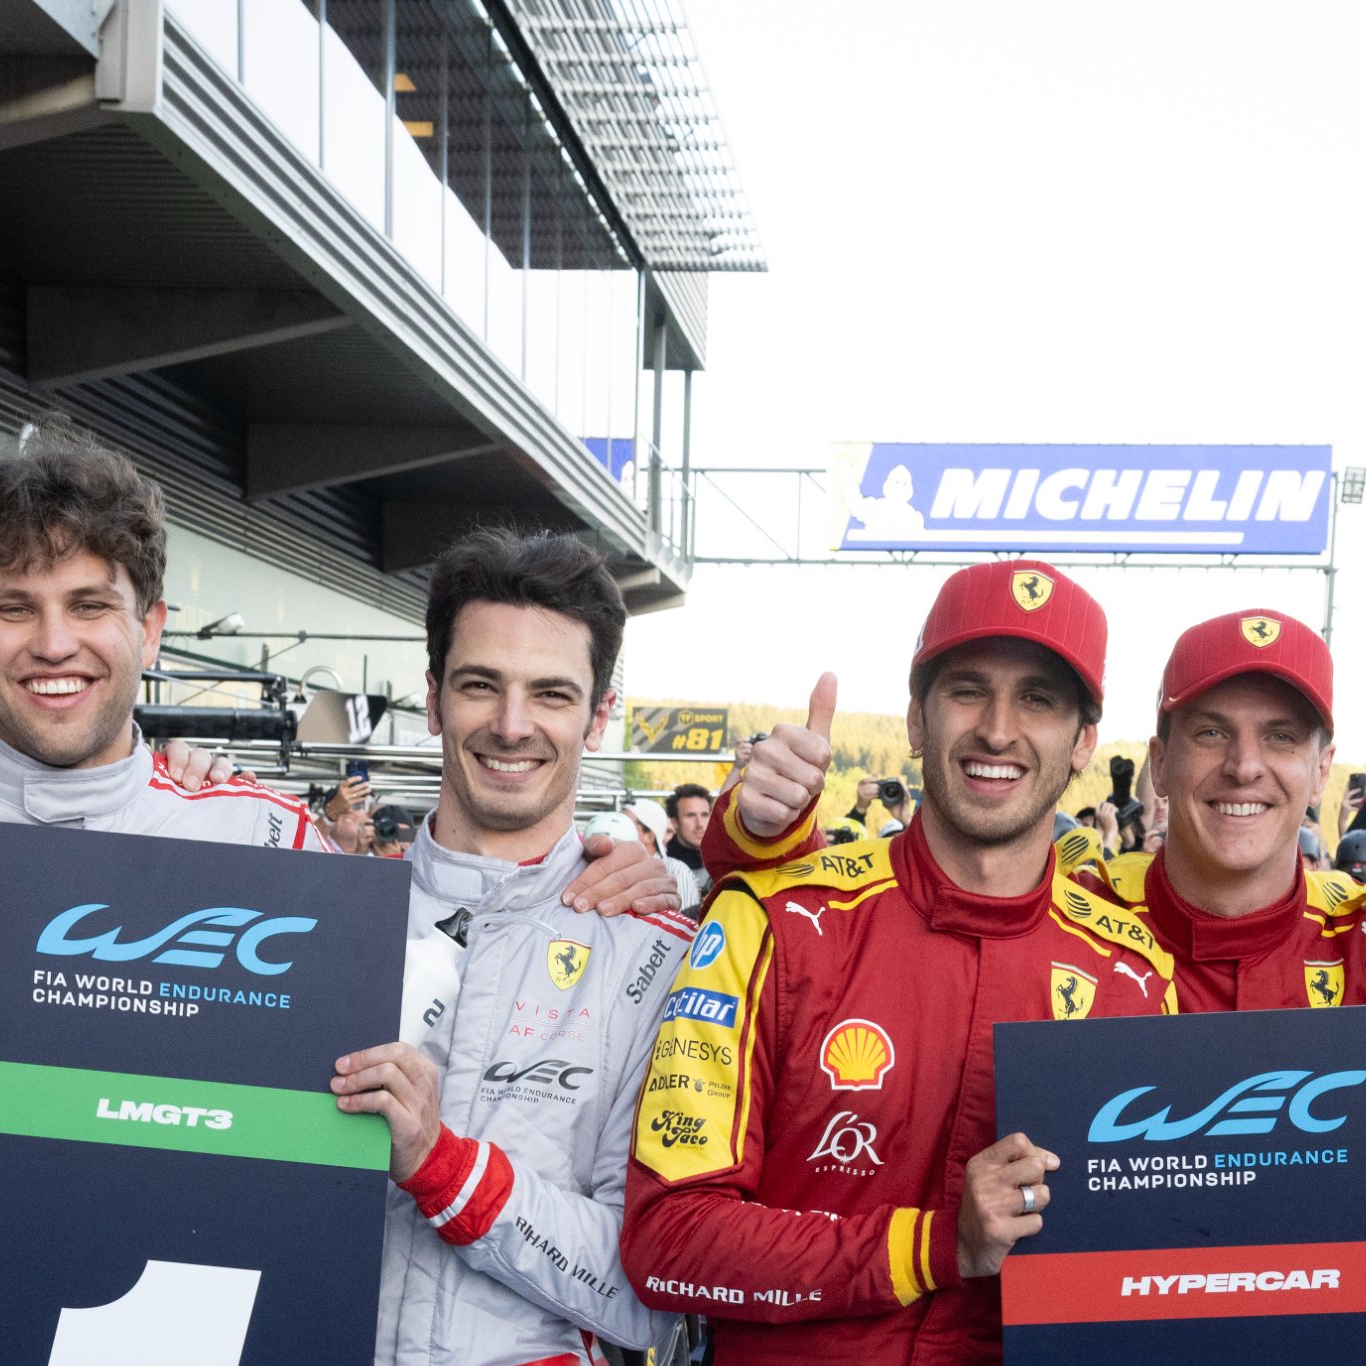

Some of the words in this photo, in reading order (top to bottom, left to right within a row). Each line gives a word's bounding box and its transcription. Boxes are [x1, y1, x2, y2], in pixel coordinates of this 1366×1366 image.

[930, 467, 1325, 522] MICHELIN
[346, 695, 371, 743] 12
[694, 714, 724, 723] SPORT
[672, 728, 724, 750] #81
[821, 851, 875, 879] AT&T
[35, 903, 318, 976] WEC
[1095, 915, 1155, 951] AT&T
[626, 938, 672, 1005] Sabelt
[33, 970, 68, 987] FIA
[75, 974, 153, 996] WORLD
[159, 982, 291, 1009] ENDURANCE
[33, 988, 200, 1018] CHAMPIONSHIP
[516, 1001, 590, 1019] VISTA
[664, 991, 734, 1021] Cetilar
[509, 1025, 535, 1037] AF
[541, 1030, 586, 1041] CORSE
[661, 1037, 732, 1066] GENESYS
[483, 1059, 594, 1090] WEC
[648, 1074, 690, 1092] ADLER
[524, 1087, 577, 1105] ENDURANCE
[96, 1098, 233, 1130] LMGT3
[651, 1110, 706, 1133] King
[662, 1126, 708, 1148] Taco
[815, 1164, 875, 1176] ESPRESSO
[1088, 1158, 1122, 1174] FIA
[1128, 1154, 1207, 1171] WORLD
[1215, 1149, 1348, 1168] ENDURANCE
[1088, 1171, 1257, 1191] CHAMPIONSHIP
[570, 1264, 620, 1300] MILLE
[645, 1275, 744, 1305] RICHARD
[753, 1288, 822, 1308] MILLE
[1121, 1269, 1340, 1296] HYPERCAR
